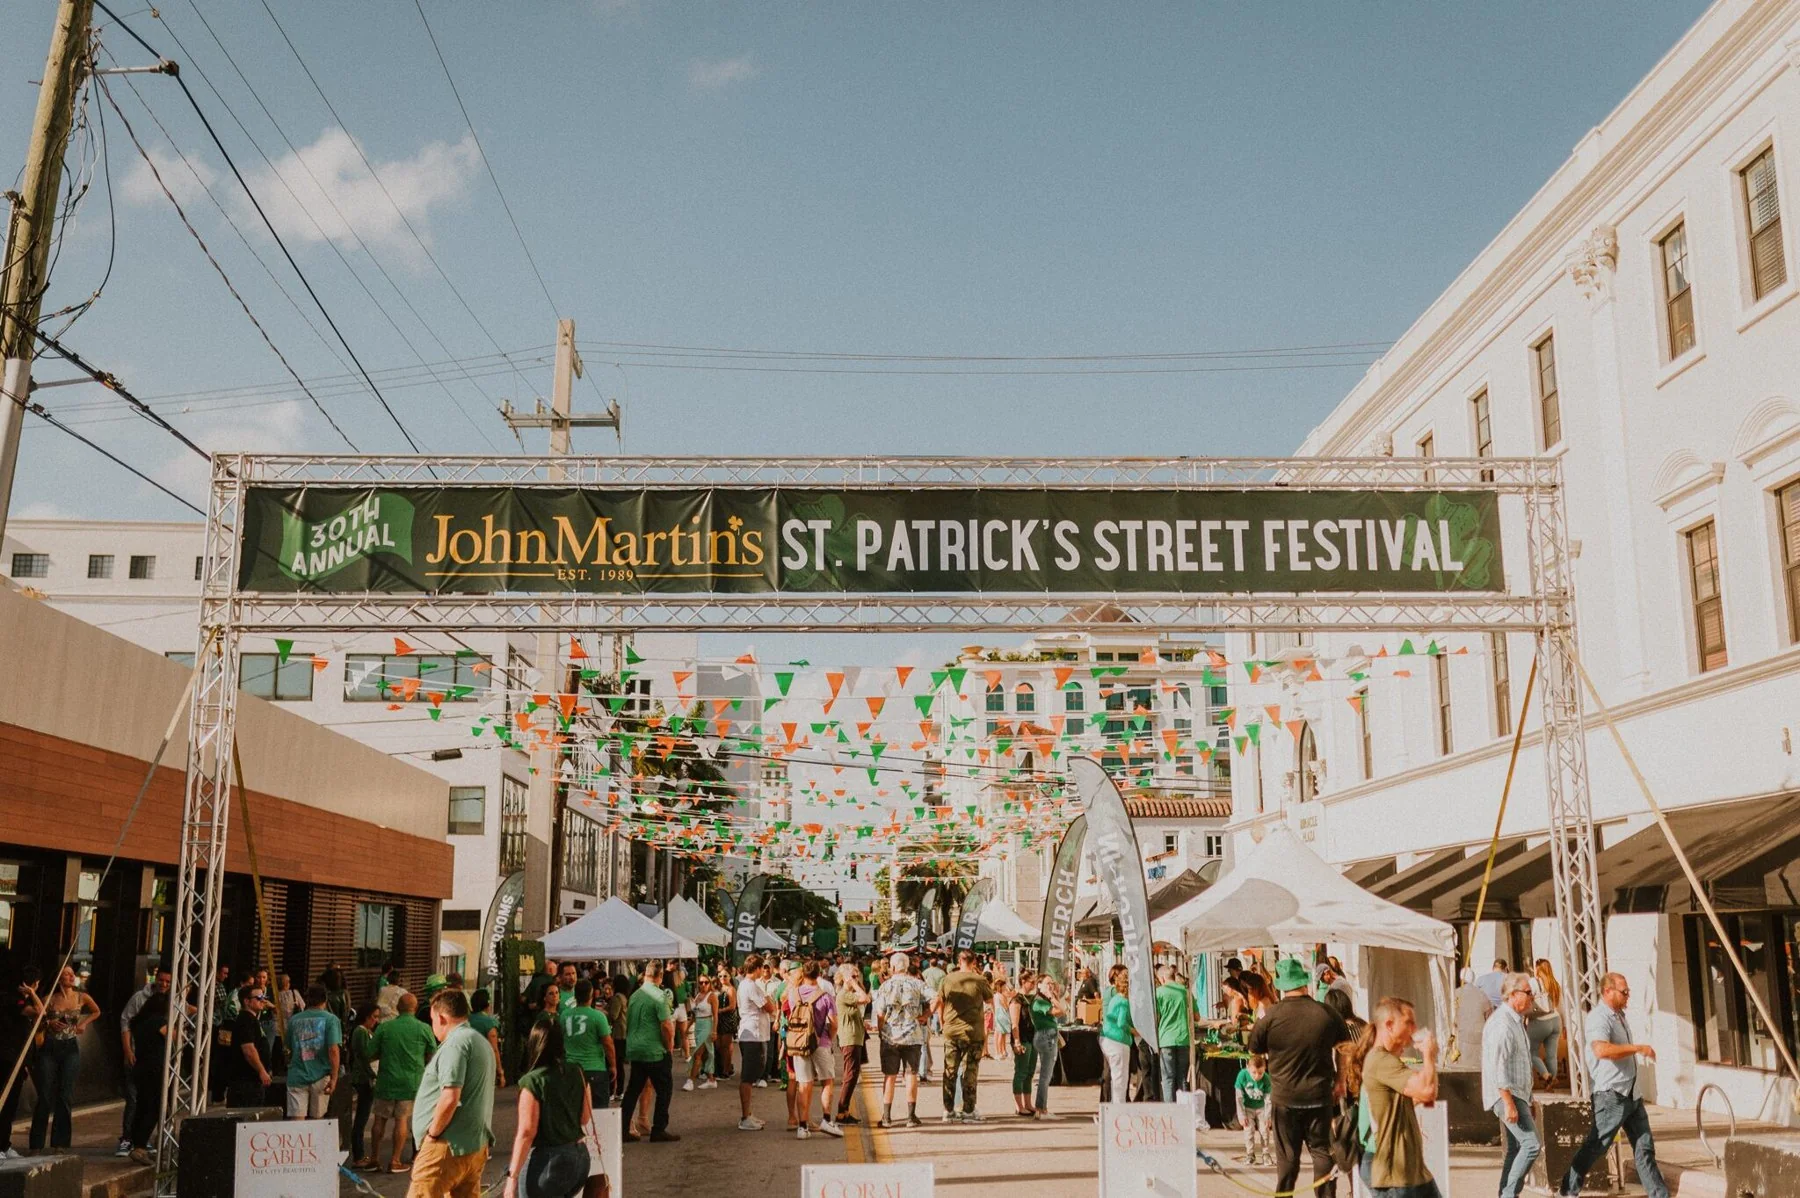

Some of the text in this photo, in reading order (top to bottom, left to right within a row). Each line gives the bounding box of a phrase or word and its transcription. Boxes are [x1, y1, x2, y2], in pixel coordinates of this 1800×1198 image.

[311, 497, 380, 548] 30TH
[291, 523, 395, 575] ANNUAL
[782, 518, 1464, 571] ST. PATRICK'S STREET FESTIVAL
[557, 569, 635, 582] EST. 1989
[736, 912, 756, 952] BAR
[958, 912, 979, 949] BAR
[1048, 868, 1075, 960] MERCH
[487, 895, 514, 976] RESTROOMS
[789, 934, 797, 952] BAR
[565, 1014, 588, 1037] 13
[1114, 1113, 1174, 1132] CORAL
[249, 1132, 316, 1152] CORAL
[250, 1149, 318, 1168] GABLES
